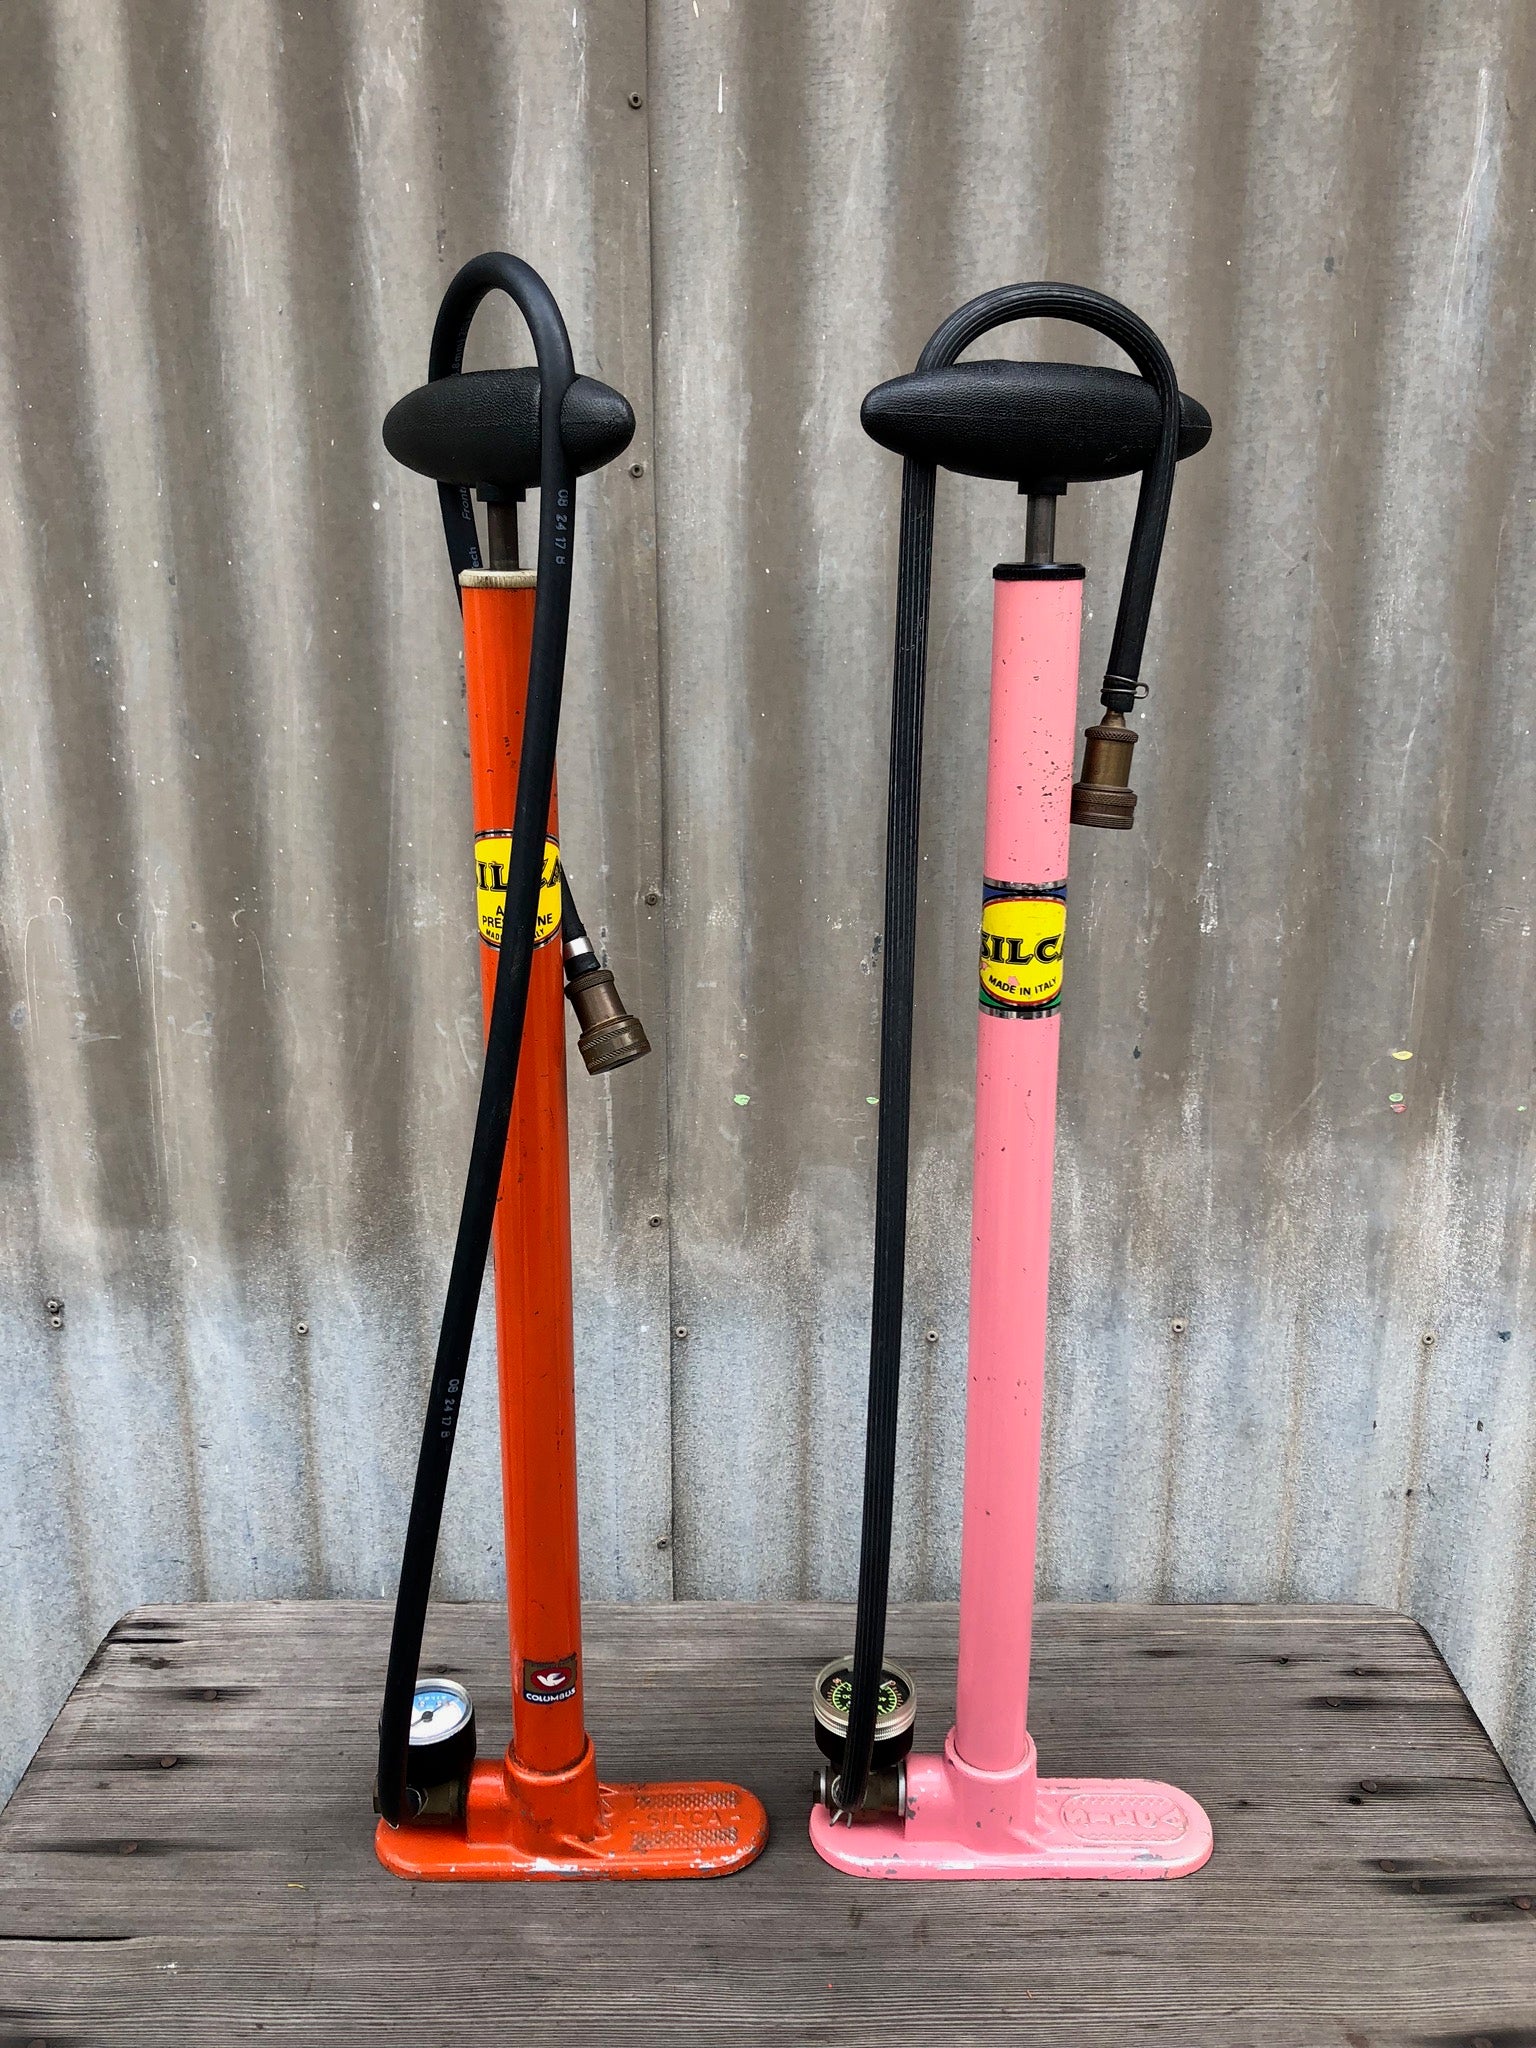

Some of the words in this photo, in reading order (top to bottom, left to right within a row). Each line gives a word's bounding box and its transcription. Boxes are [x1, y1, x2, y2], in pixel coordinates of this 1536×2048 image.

[555, 513, 568, 531] 24
[555, 537, 567, 550] 17
[469, 546, 479, 569] ech
[988, 975, 1016, 994] MADE
[1019, 987, 1031, 995] IN
[1035, 976, 1056, 994] ITALY
[441, 1416, 452, 1426] 17
[526, 1687, 576, 1702] COLUMBUS
[647, 1811, 722, 1829] SILCA
